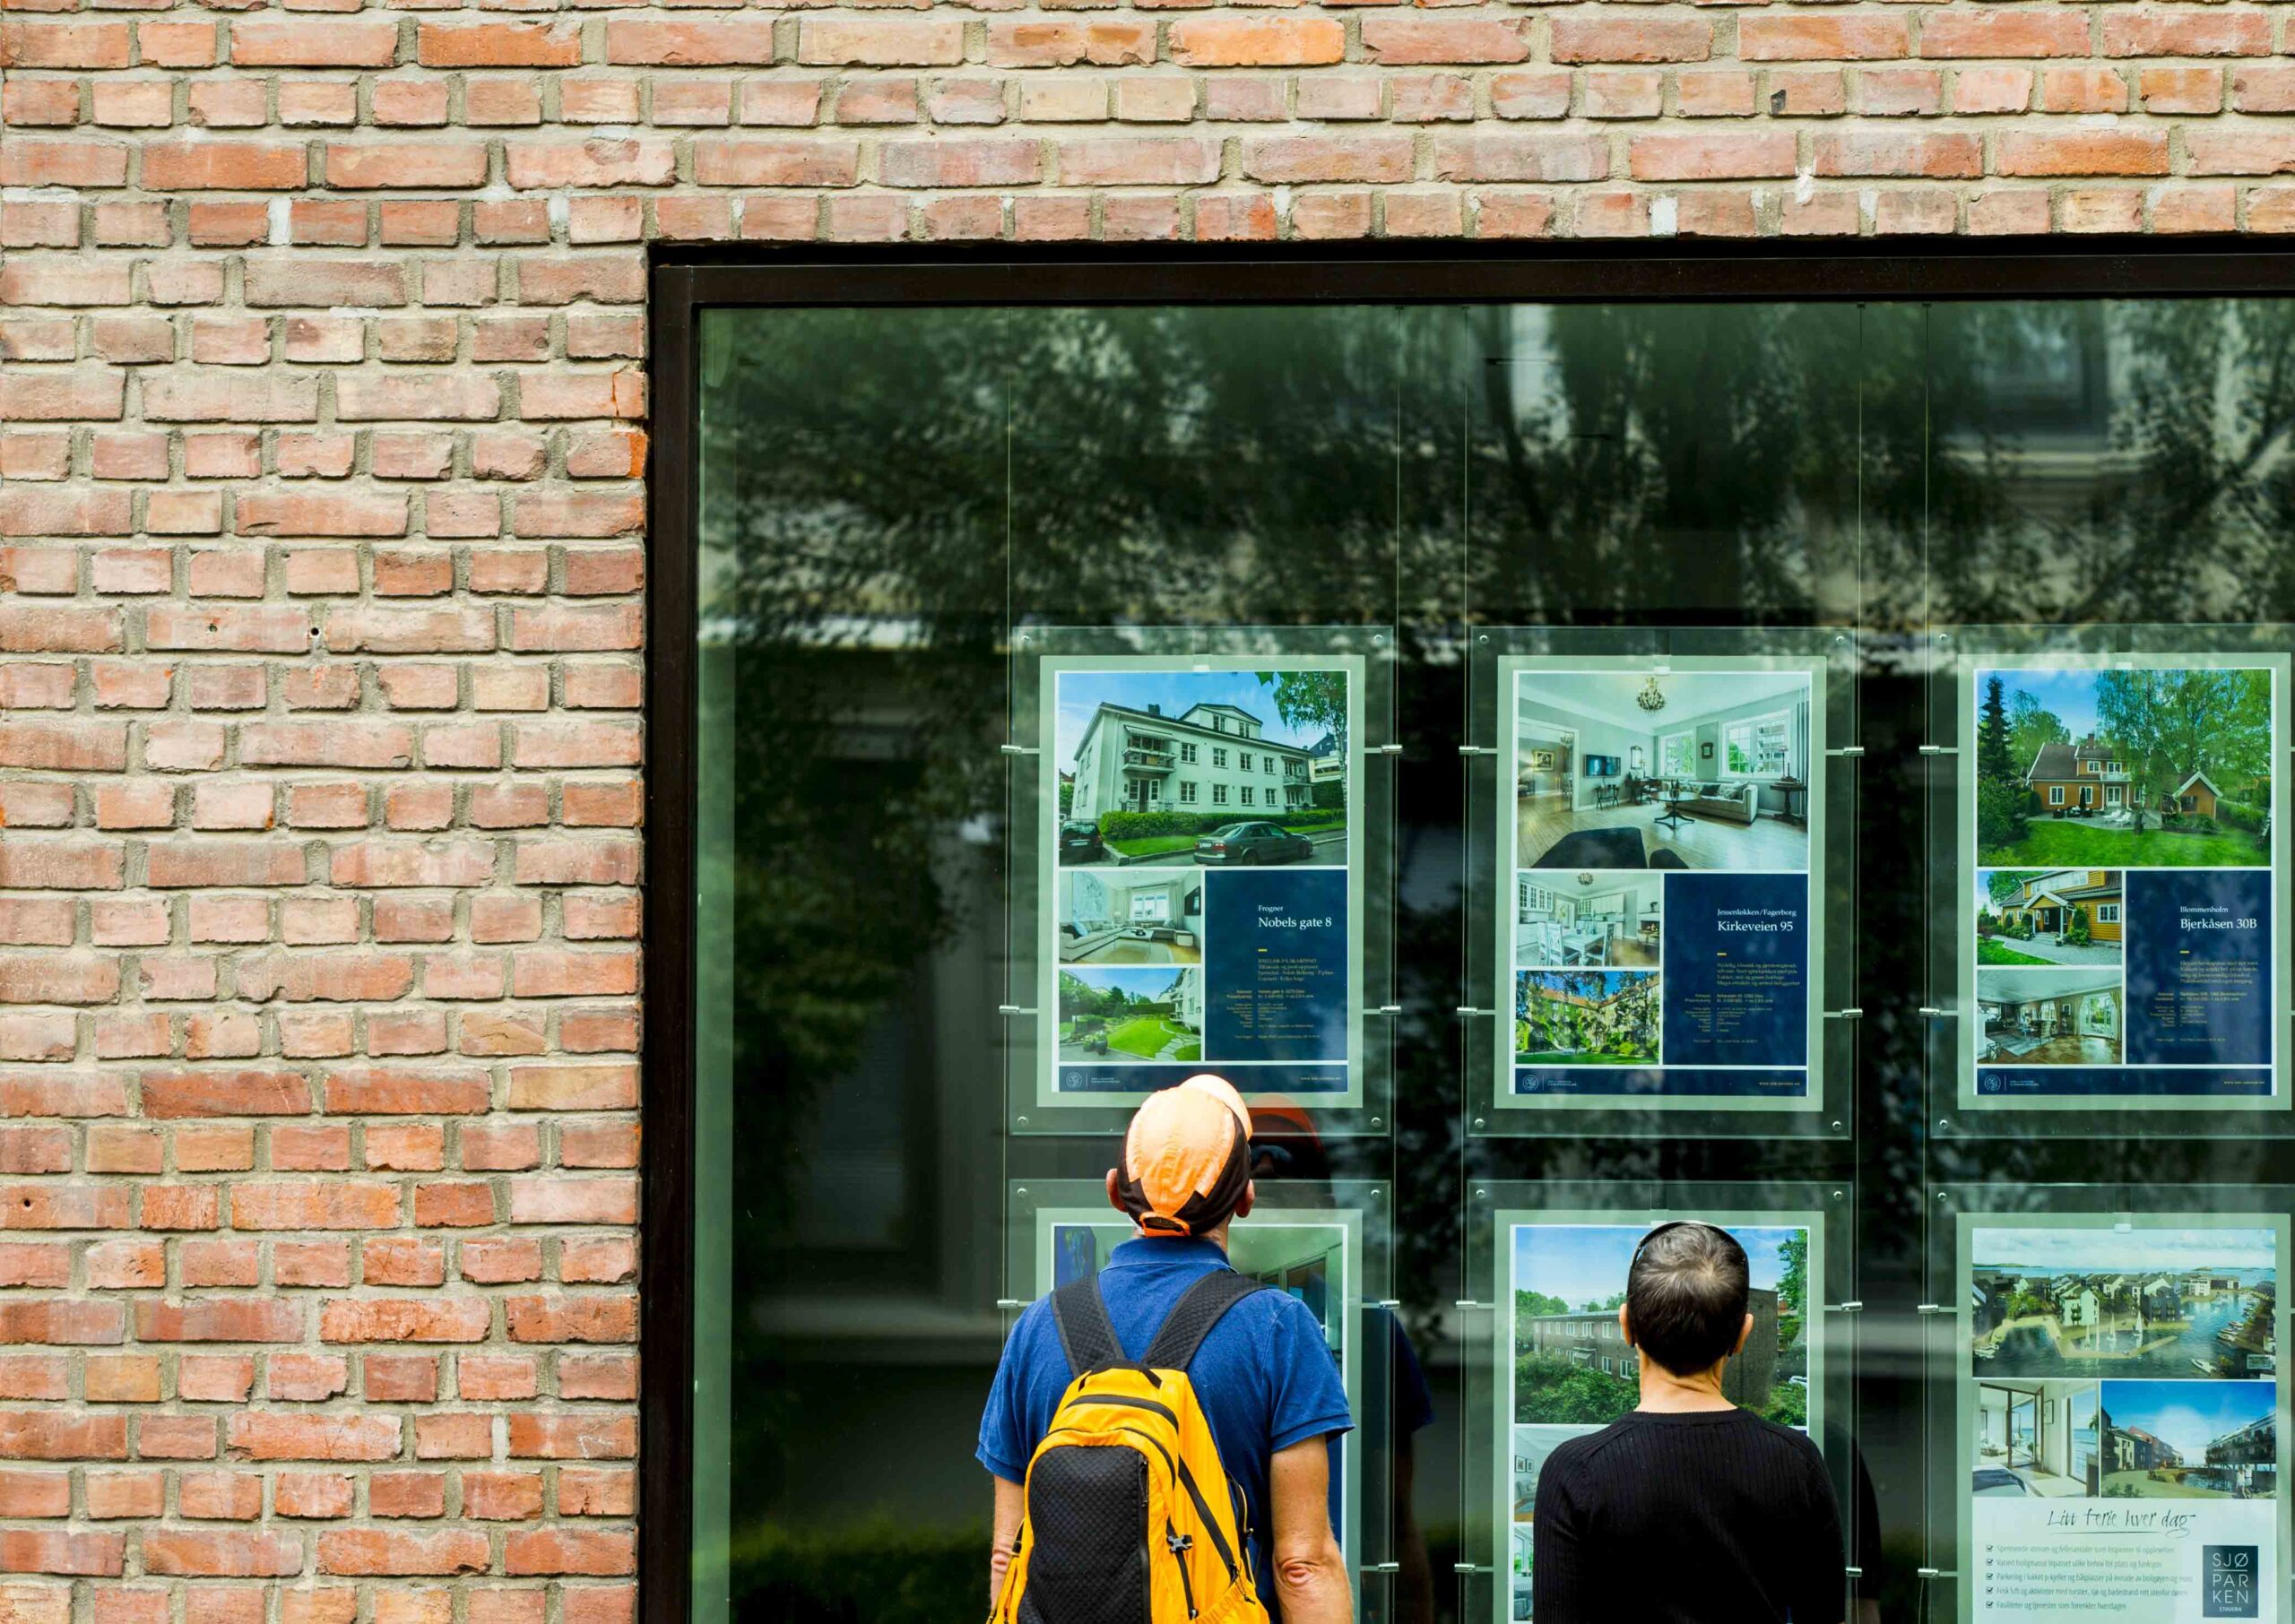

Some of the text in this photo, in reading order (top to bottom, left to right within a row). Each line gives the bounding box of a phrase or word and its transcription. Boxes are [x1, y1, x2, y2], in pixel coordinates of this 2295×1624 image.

[1258, 904, 1284, 913] Frogner
[2179, 905, 2229, 913] Blommenholm
[1258, 916, 1332, 930] Nobels gate 8
[1718, 920, 1794, 932] Kirkeveien 95
[2180, 918, 2257, 931] Bjerkåsen 30B
[2046, 1507, 2196, 1539] Litt ferie hver dag
[2213, 1552, 2248, 1568] SJØ
[2213, 1574, 2248, 1587] PAR
[2213, 1589, 2248, 1603] KEN
